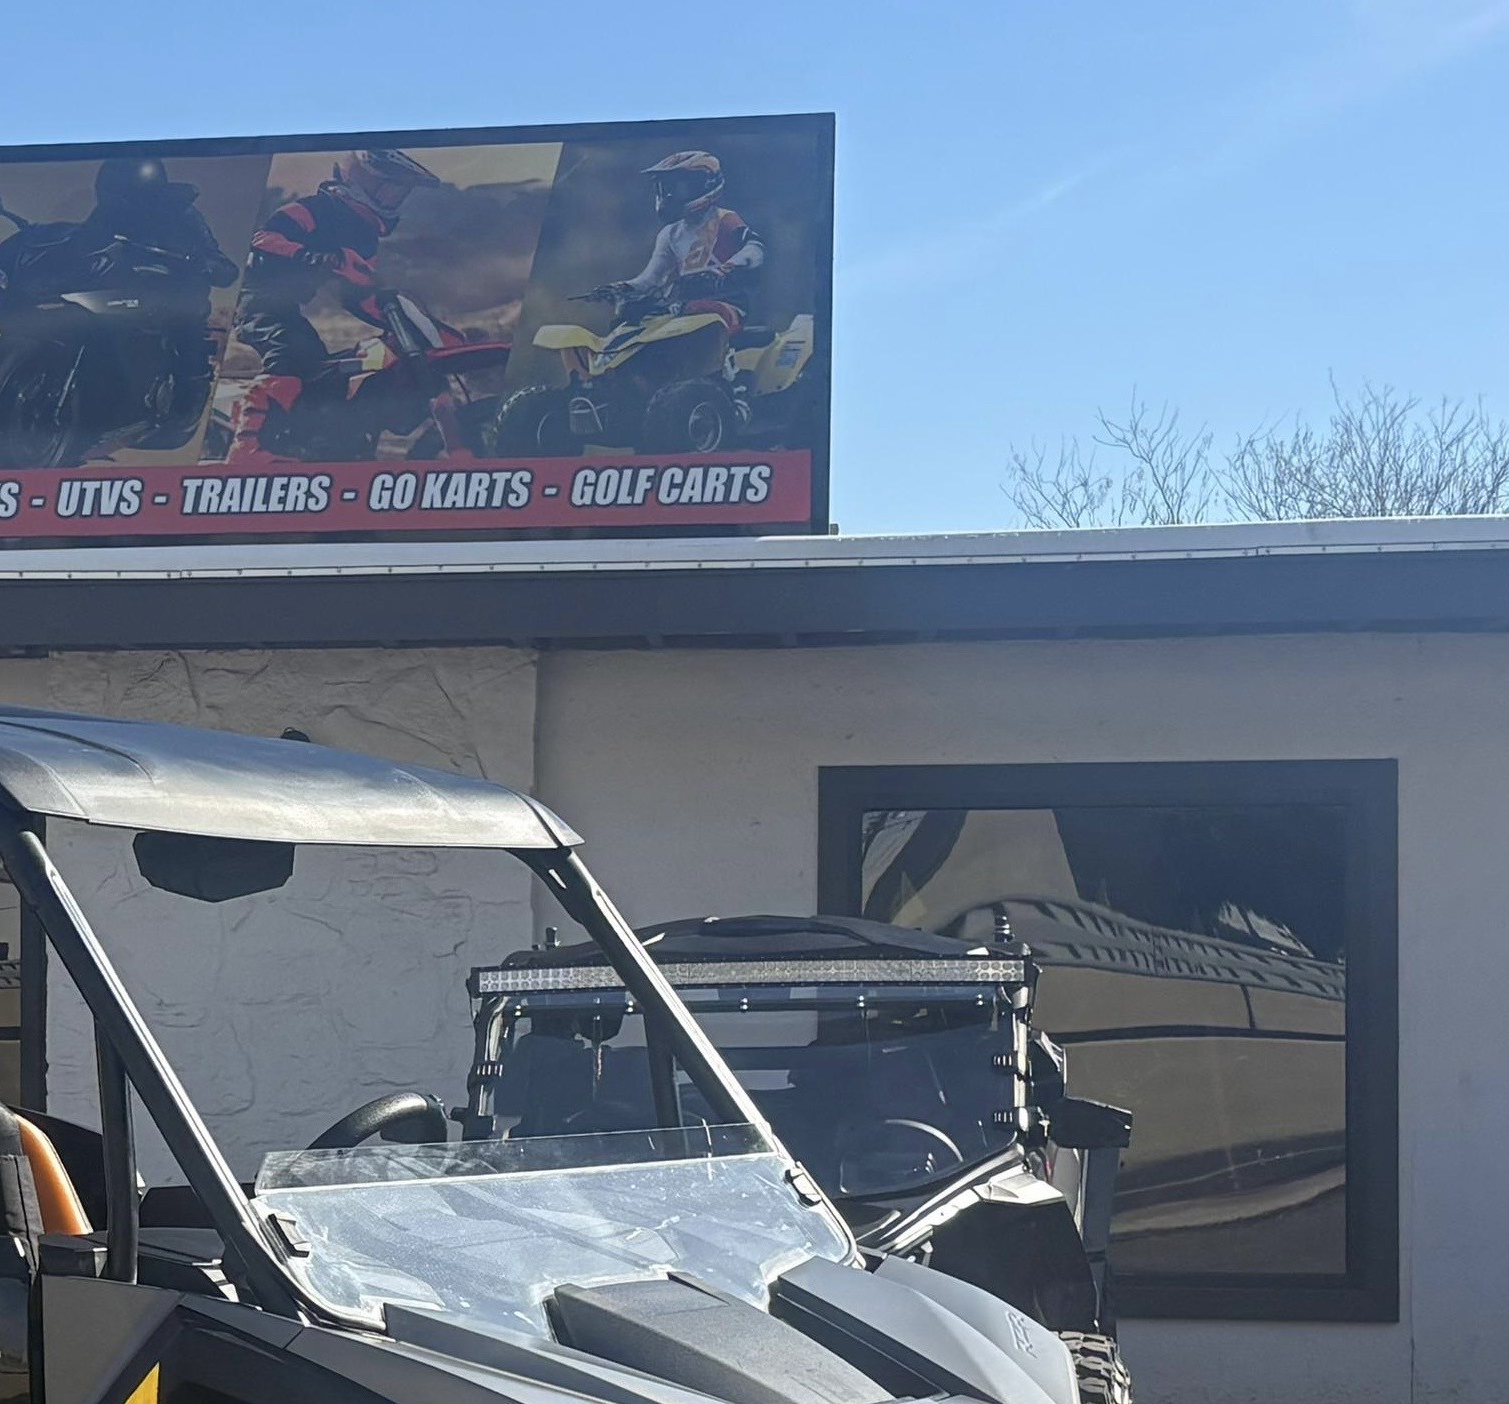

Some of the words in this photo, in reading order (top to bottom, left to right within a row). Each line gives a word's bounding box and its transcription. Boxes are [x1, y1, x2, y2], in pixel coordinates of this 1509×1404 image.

[56, 478, 141, 517] UTVS
[181, 474, 332, 514] TRAILERS
[369, 473, 421, 512] GO
[422, 470, 532, 511] KARTS
[571, 466, 655, 507] GOLF
[658, 463, 772, 504] CARTS
